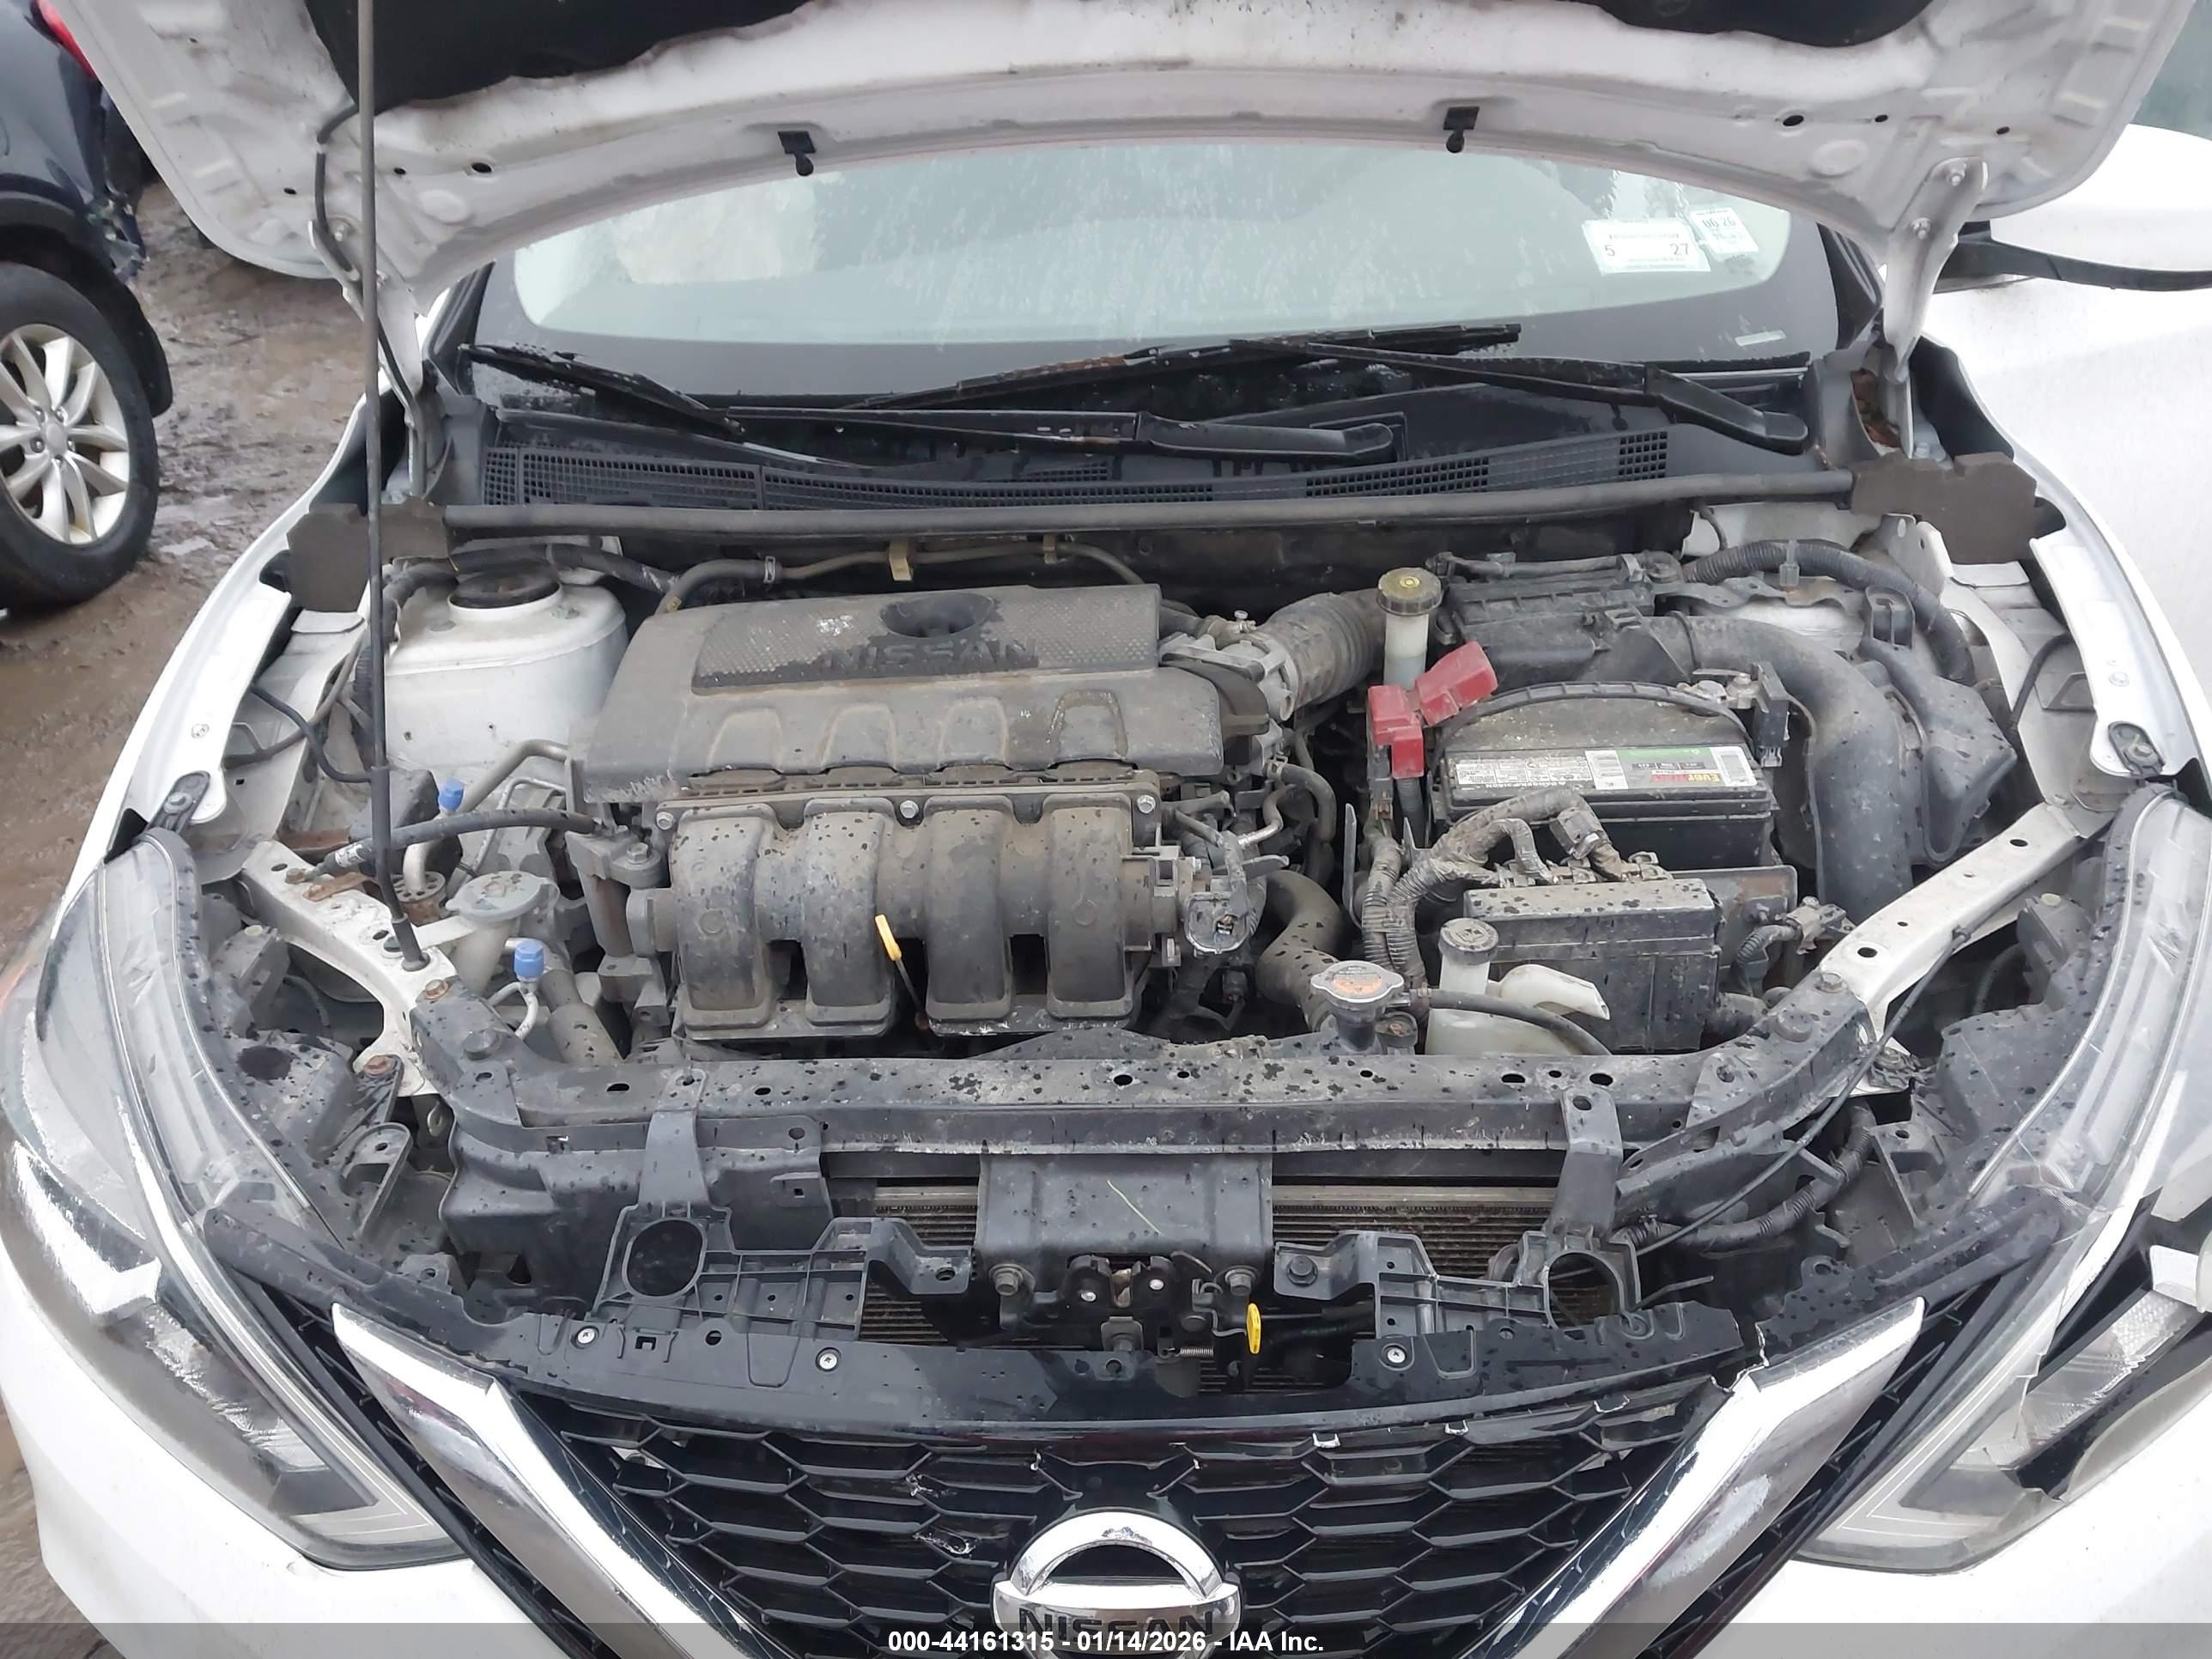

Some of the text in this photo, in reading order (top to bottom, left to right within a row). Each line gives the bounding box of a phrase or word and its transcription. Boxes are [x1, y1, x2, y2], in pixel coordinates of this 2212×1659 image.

[1604, 243, 1689, 256] 5 27
[825, 639, 1037, 672] NISSAN
[1019, 1608, 1212, 1644] NISSAN
